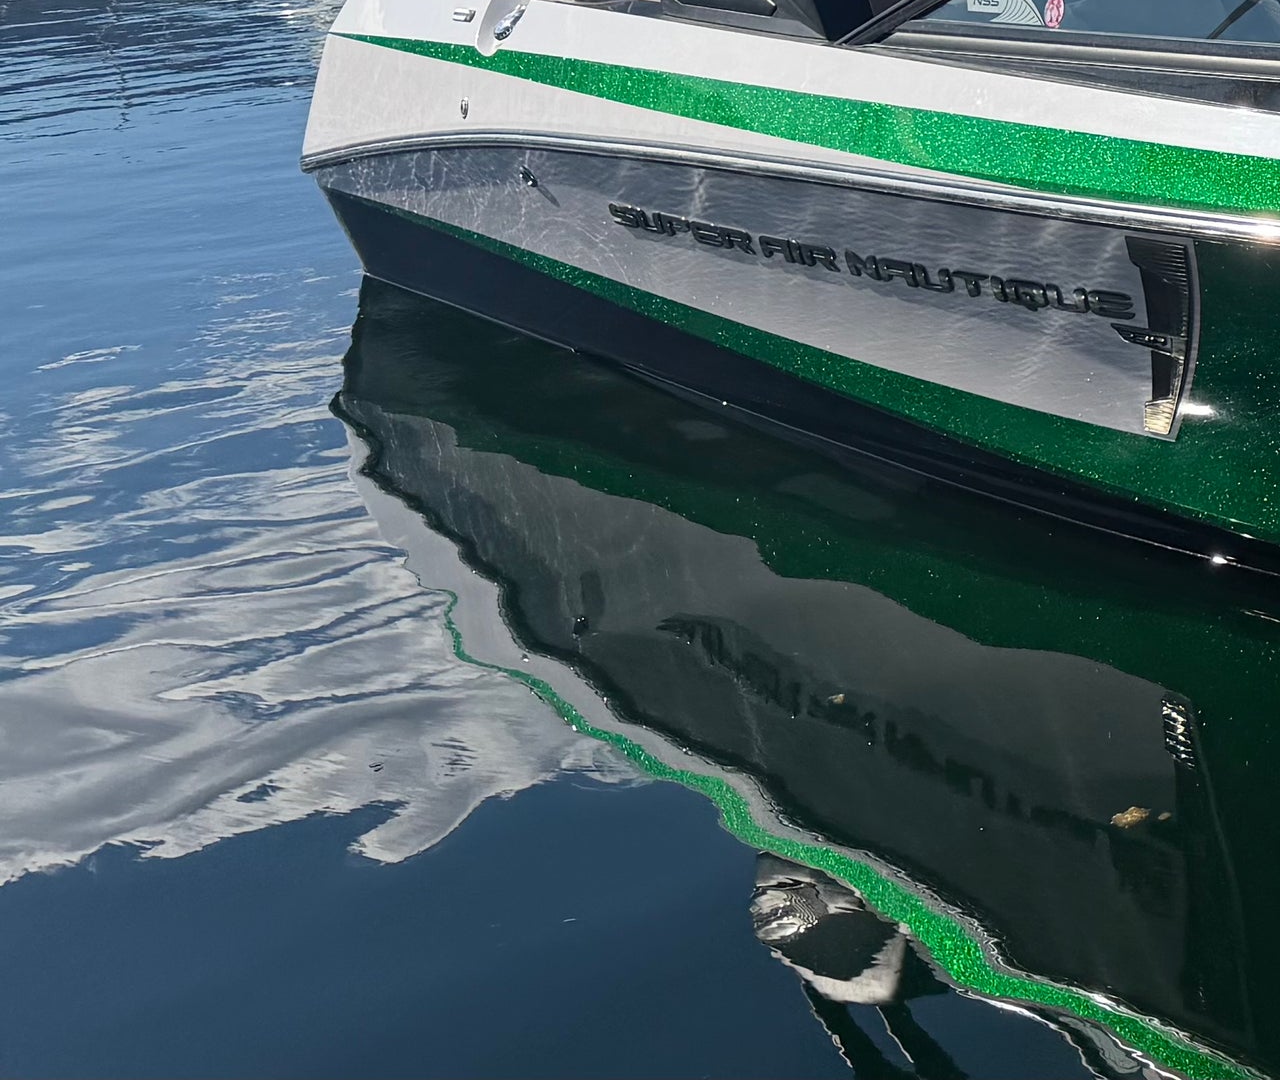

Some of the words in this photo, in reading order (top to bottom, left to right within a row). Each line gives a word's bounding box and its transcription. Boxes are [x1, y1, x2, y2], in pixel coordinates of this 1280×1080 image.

[608, 203, 758, 256] SUPER
[758, 234, 841, 273] AIR
[845, 248, 1136, 320] NAUTIQUE
